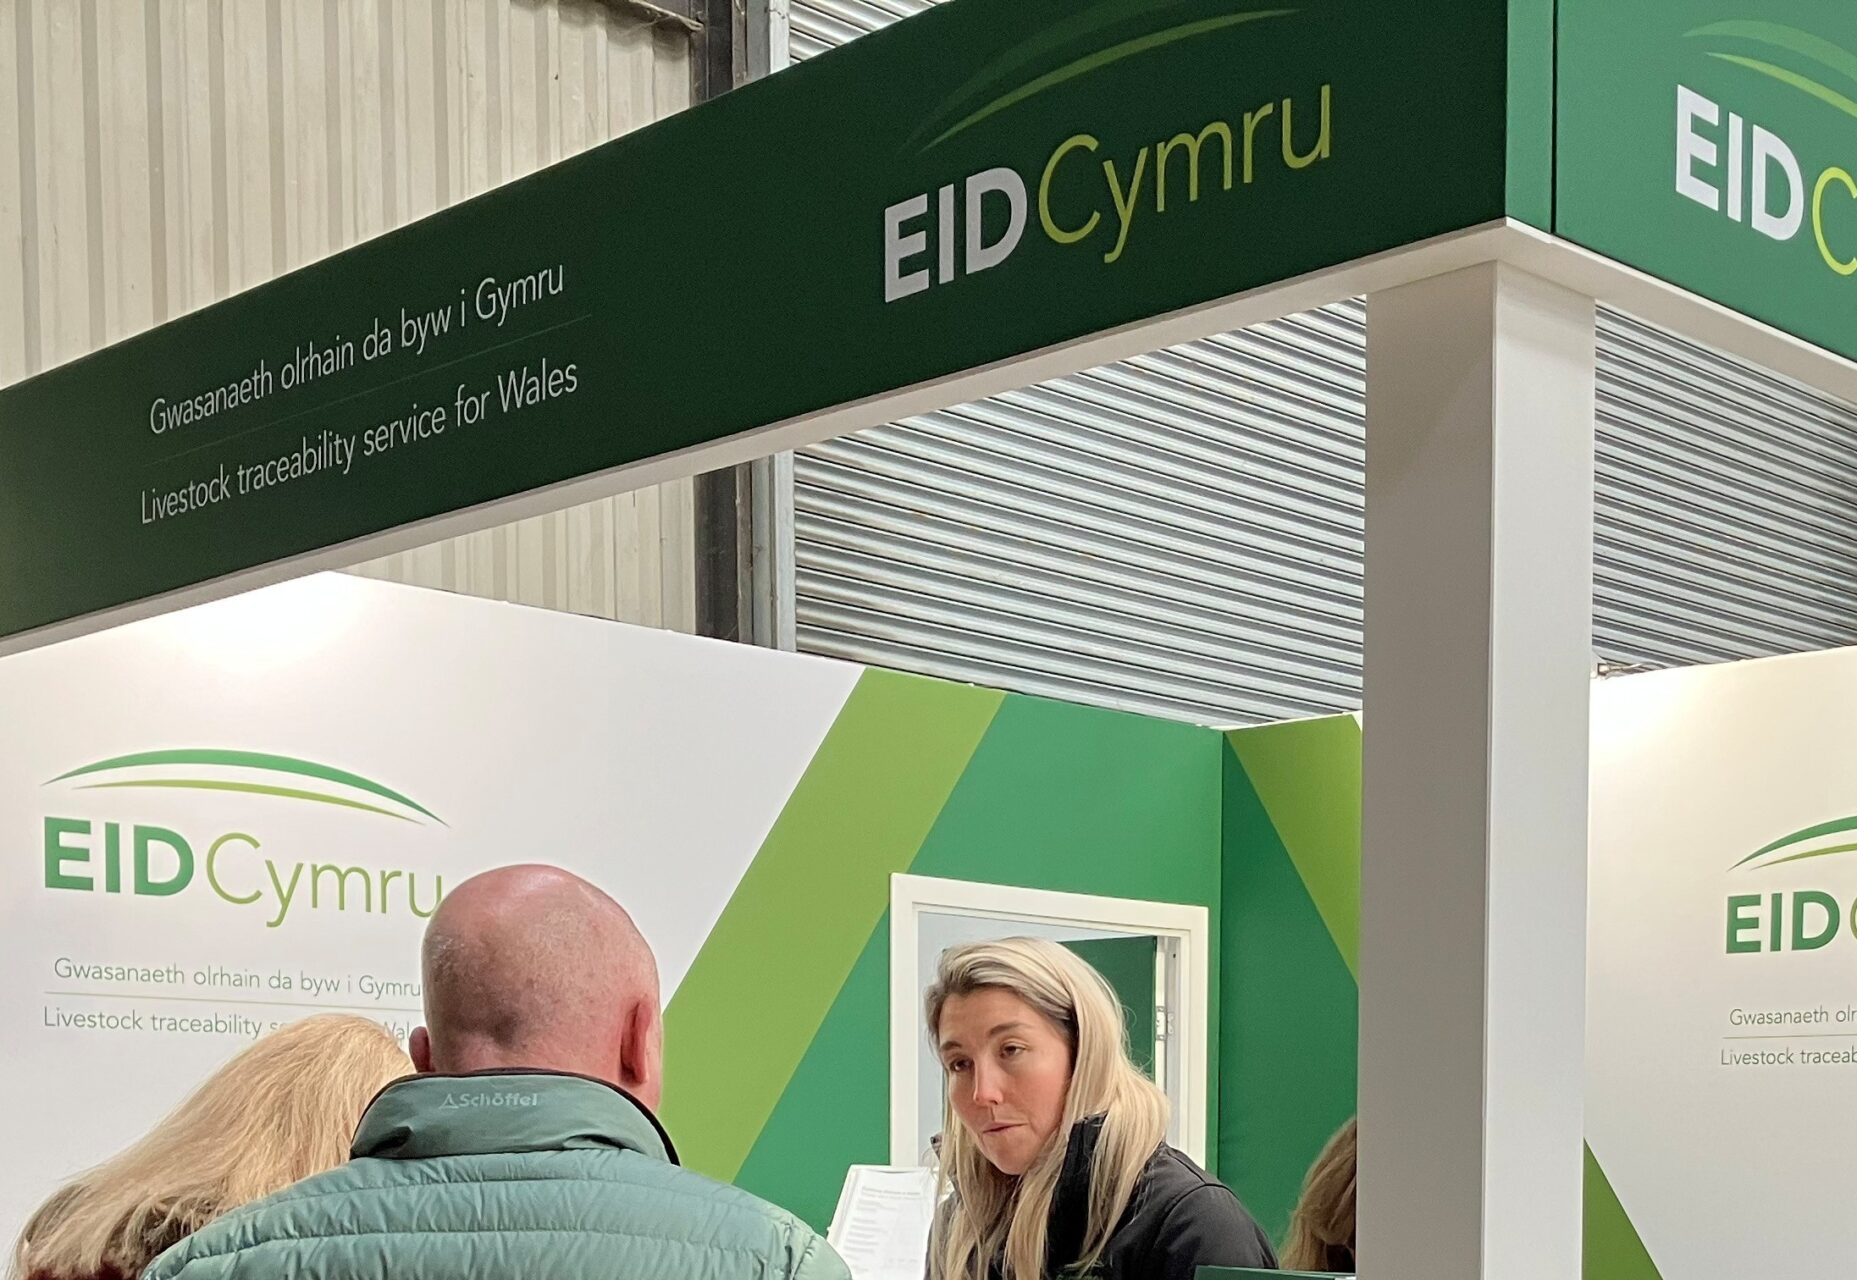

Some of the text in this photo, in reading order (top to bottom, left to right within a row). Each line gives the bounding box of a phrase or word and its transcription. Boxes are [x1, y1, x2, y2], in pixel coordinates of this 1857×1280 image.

[885, 83, 1331, 303] EIDCymru
[149, 264, 565, 435] Gwasanaeth olrhain da byw i Gymru
[140, 357, 578, 524] Livestock traceability service for Wales
[43, 816, 443, 928] EIDCymru
[1725, 890, 1857, 954] EID
[54, 957, 421, 1001] Gwasanaeth olrhain da byw i Gymru
[43, 1006, 144, 1032] Livestock
[151, 1012, 262, 1039] traceability
[1729, 1005, 1829, 1026] Gwasanaeth
[1720, 1048, 1794, 1066] Livestock
[459, 1092, 538, 1108] Schöffel
